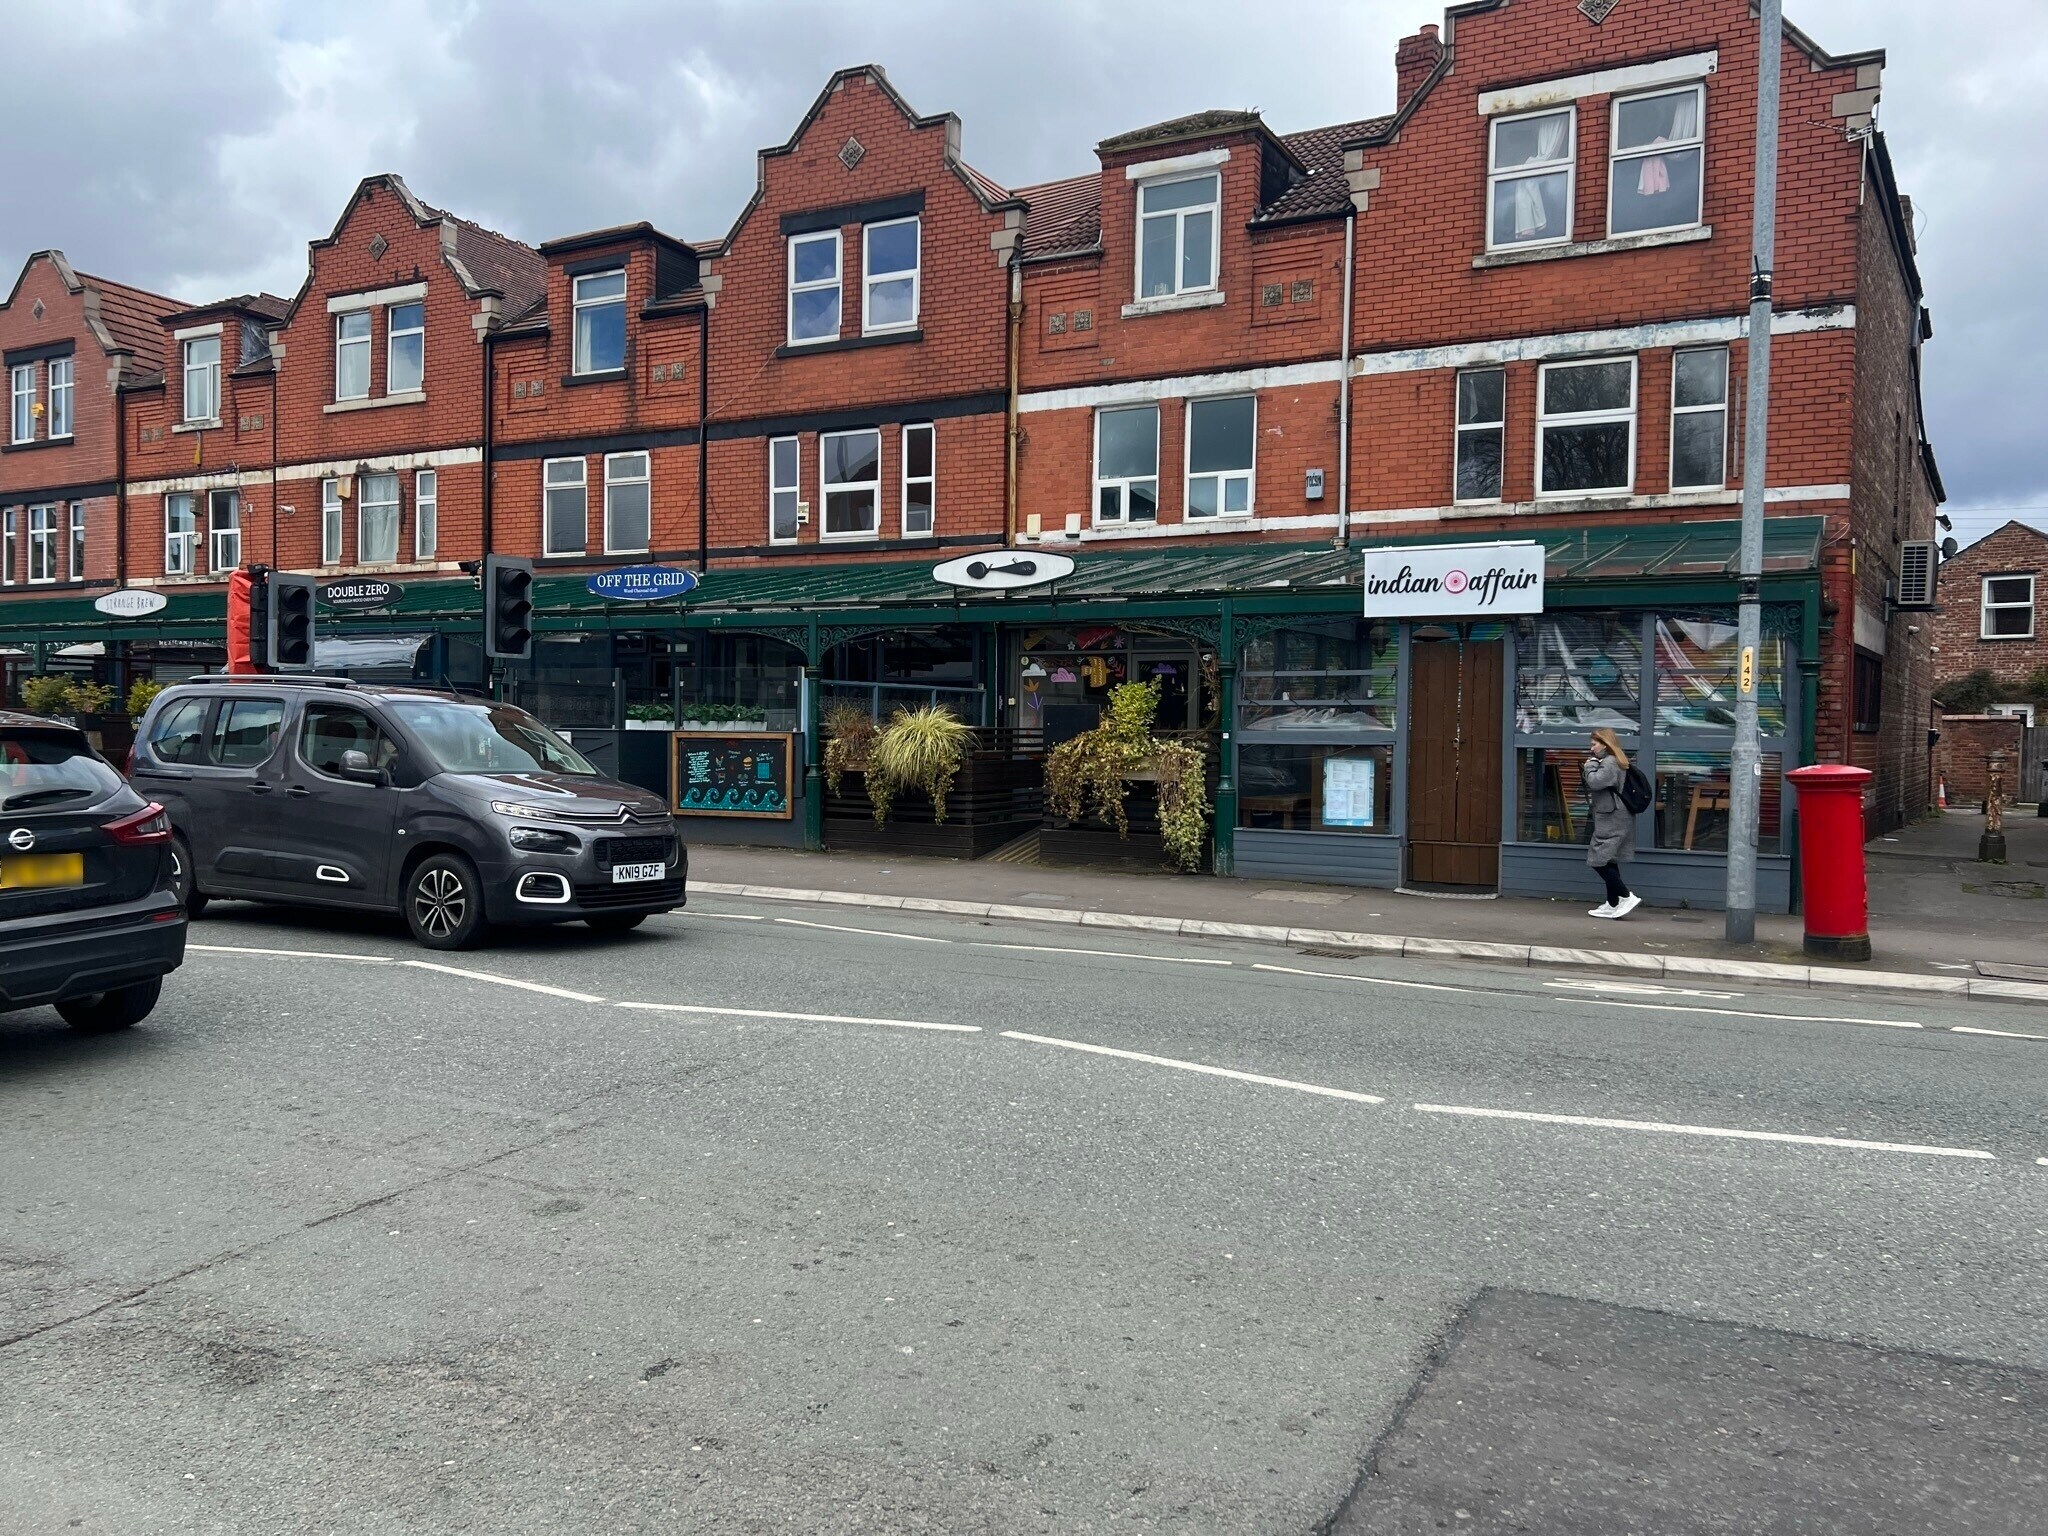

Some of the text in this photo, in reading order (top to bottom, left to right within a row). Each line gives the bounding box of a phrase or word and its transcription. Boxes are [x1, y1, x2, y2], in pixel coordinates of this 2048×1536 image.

[597, 572, 685, 588] OFF THE GRID
[1367, 565, 1537, 606] indian affair
[327, 583, 390, 598] DOUBLE ZERO
[105, 596, 155, 610] STRANGE BREW
[618, 864, 660, 879] KN19 GZF
